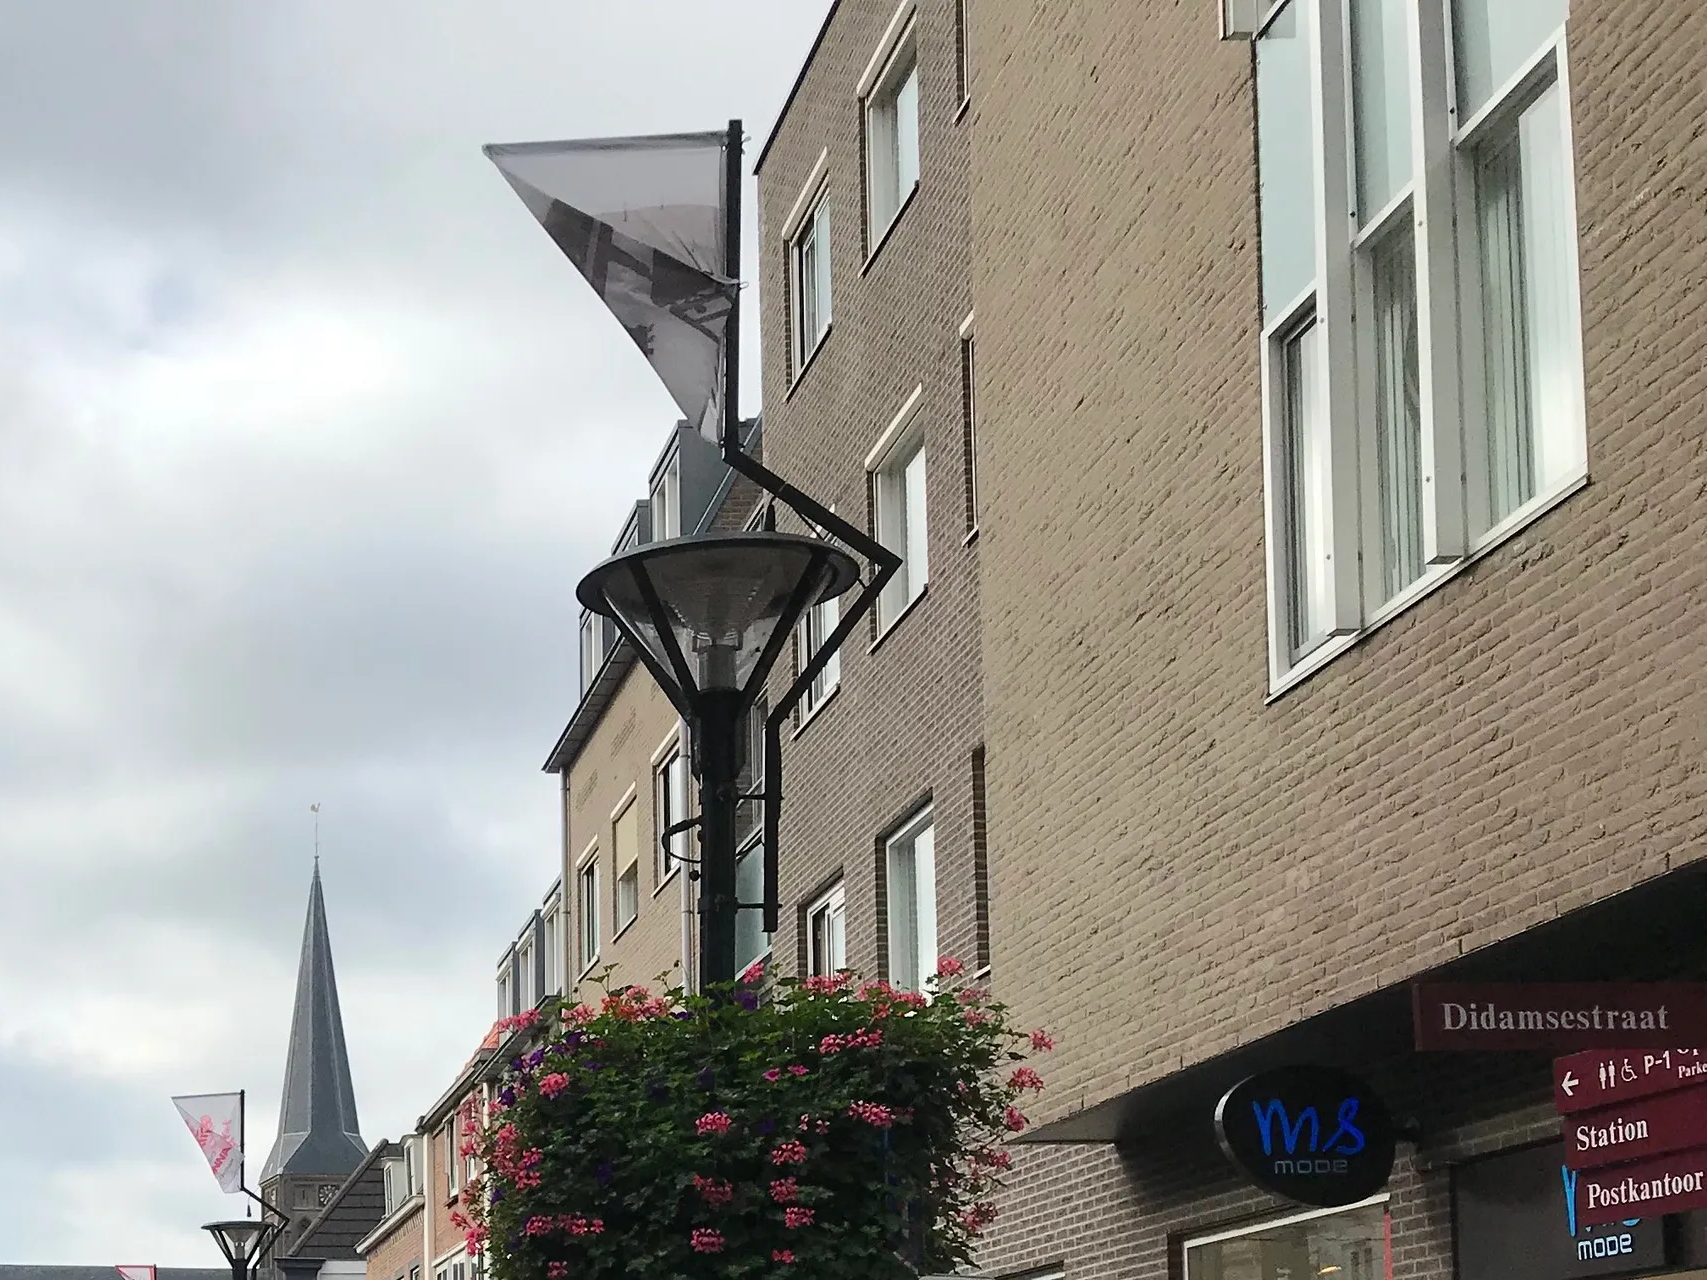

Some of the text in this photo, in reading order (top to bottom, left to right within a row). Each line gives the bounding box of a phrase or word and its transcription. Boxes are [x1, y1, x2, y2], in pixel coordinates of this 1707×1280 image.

[1441, 1002, 1670, 1031] Didamsestraat
[1576, 1117, 1649, 1151] Station
[1587, 1171, 1704, 1209] Postkantoor
